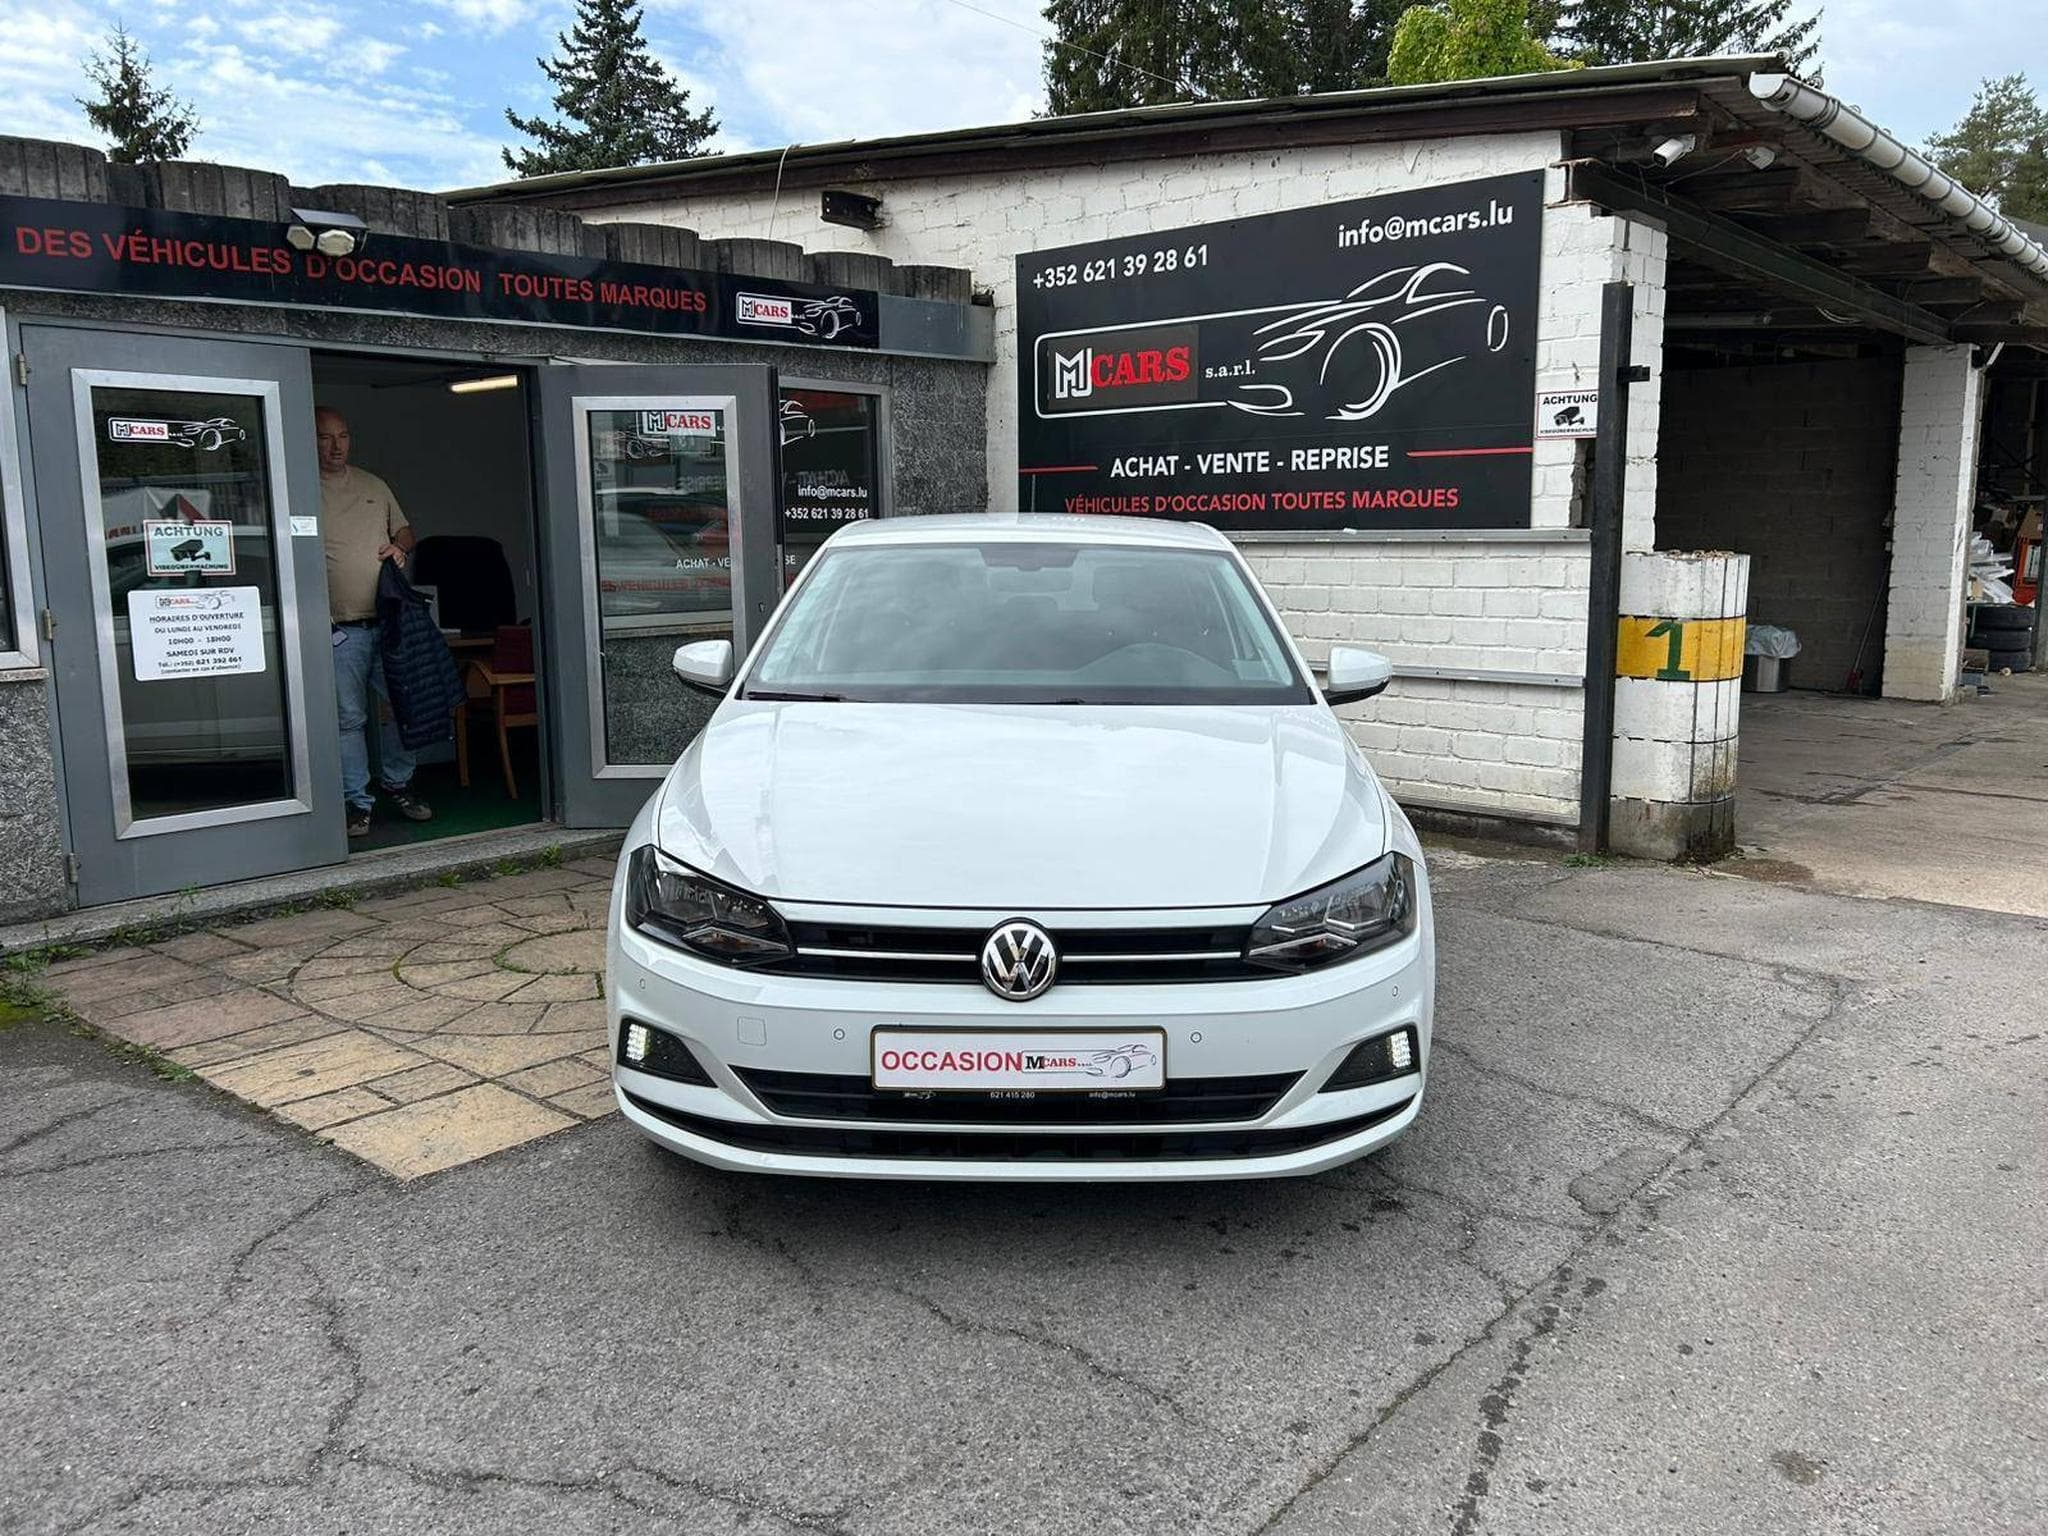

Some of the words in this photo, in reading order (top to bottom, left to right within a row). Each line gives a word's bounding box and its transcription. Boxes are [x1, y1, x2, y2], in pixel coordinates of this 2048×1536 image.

[1338, 200, 1513, 248] info@mcars.lu
[16, 226, 93, 258] DES
[102, 228, 292, 275] VÉHICULES
[306, 255, 481, 293] D'OCCASION
[500, 272, 595, 303] TOUTES
[601, 282, 707, 313] MARQUES
[1033, 264, 1077, 289] +352
[1083, 258, 1116, 282] 621
[1123, 254, 1148, 277] 39
[1153, 249, 1178, 273] 28
[1184, 244, 1208, 268] 61
[1205, 360, 1256, 378] s.a.r.l.
[1542, 394, 1598, 405] ACHTUNG
[1110, 455, 1179, 479] ACHAT
[1198, 451, 1272, 475] VENTE
[1290, 446, 1389, 471] REPRISE
[798, 485, 868, 500] info@mcars.lu
[1065, 491, 1150, 514] VÉHICULES
[1155, 491, 1266, 513] D'OCCASION
[1271, 490, 1346, 510] TOUTES
[1351, 488, 1459, 510] MARQUES
[785, 507, 809, 519] +352
[811, 508, 828, 519] 621
[831, 508, 843, 519] 39
[844, 508, 857, 519] 28
[858, 508, 869, 519] 61
[154, 526, 224, 537] ACHTUNG
[676, 558, 709, 569] ACHAT
[717, 557, 731, 568] VE
[149, 614, 191, 624] HORAIRES
[192, 611, 245, 621] D'OUVERTURE
[167, 625, 191, 634] LUNDI
[204, 622, 242, 632] VENDREDI
[168, 637, 194, 645] 10H00
[166, 649, 199, 657] SAMEDI
[200, 648, 217, 656] SUR
[218, 647, 235, 655] RDV
[1645, 621, 1691, 682] 1
[882, 1050, 1022, 1071] OCCASION
[990, 1091, 1004, 1099] 621
